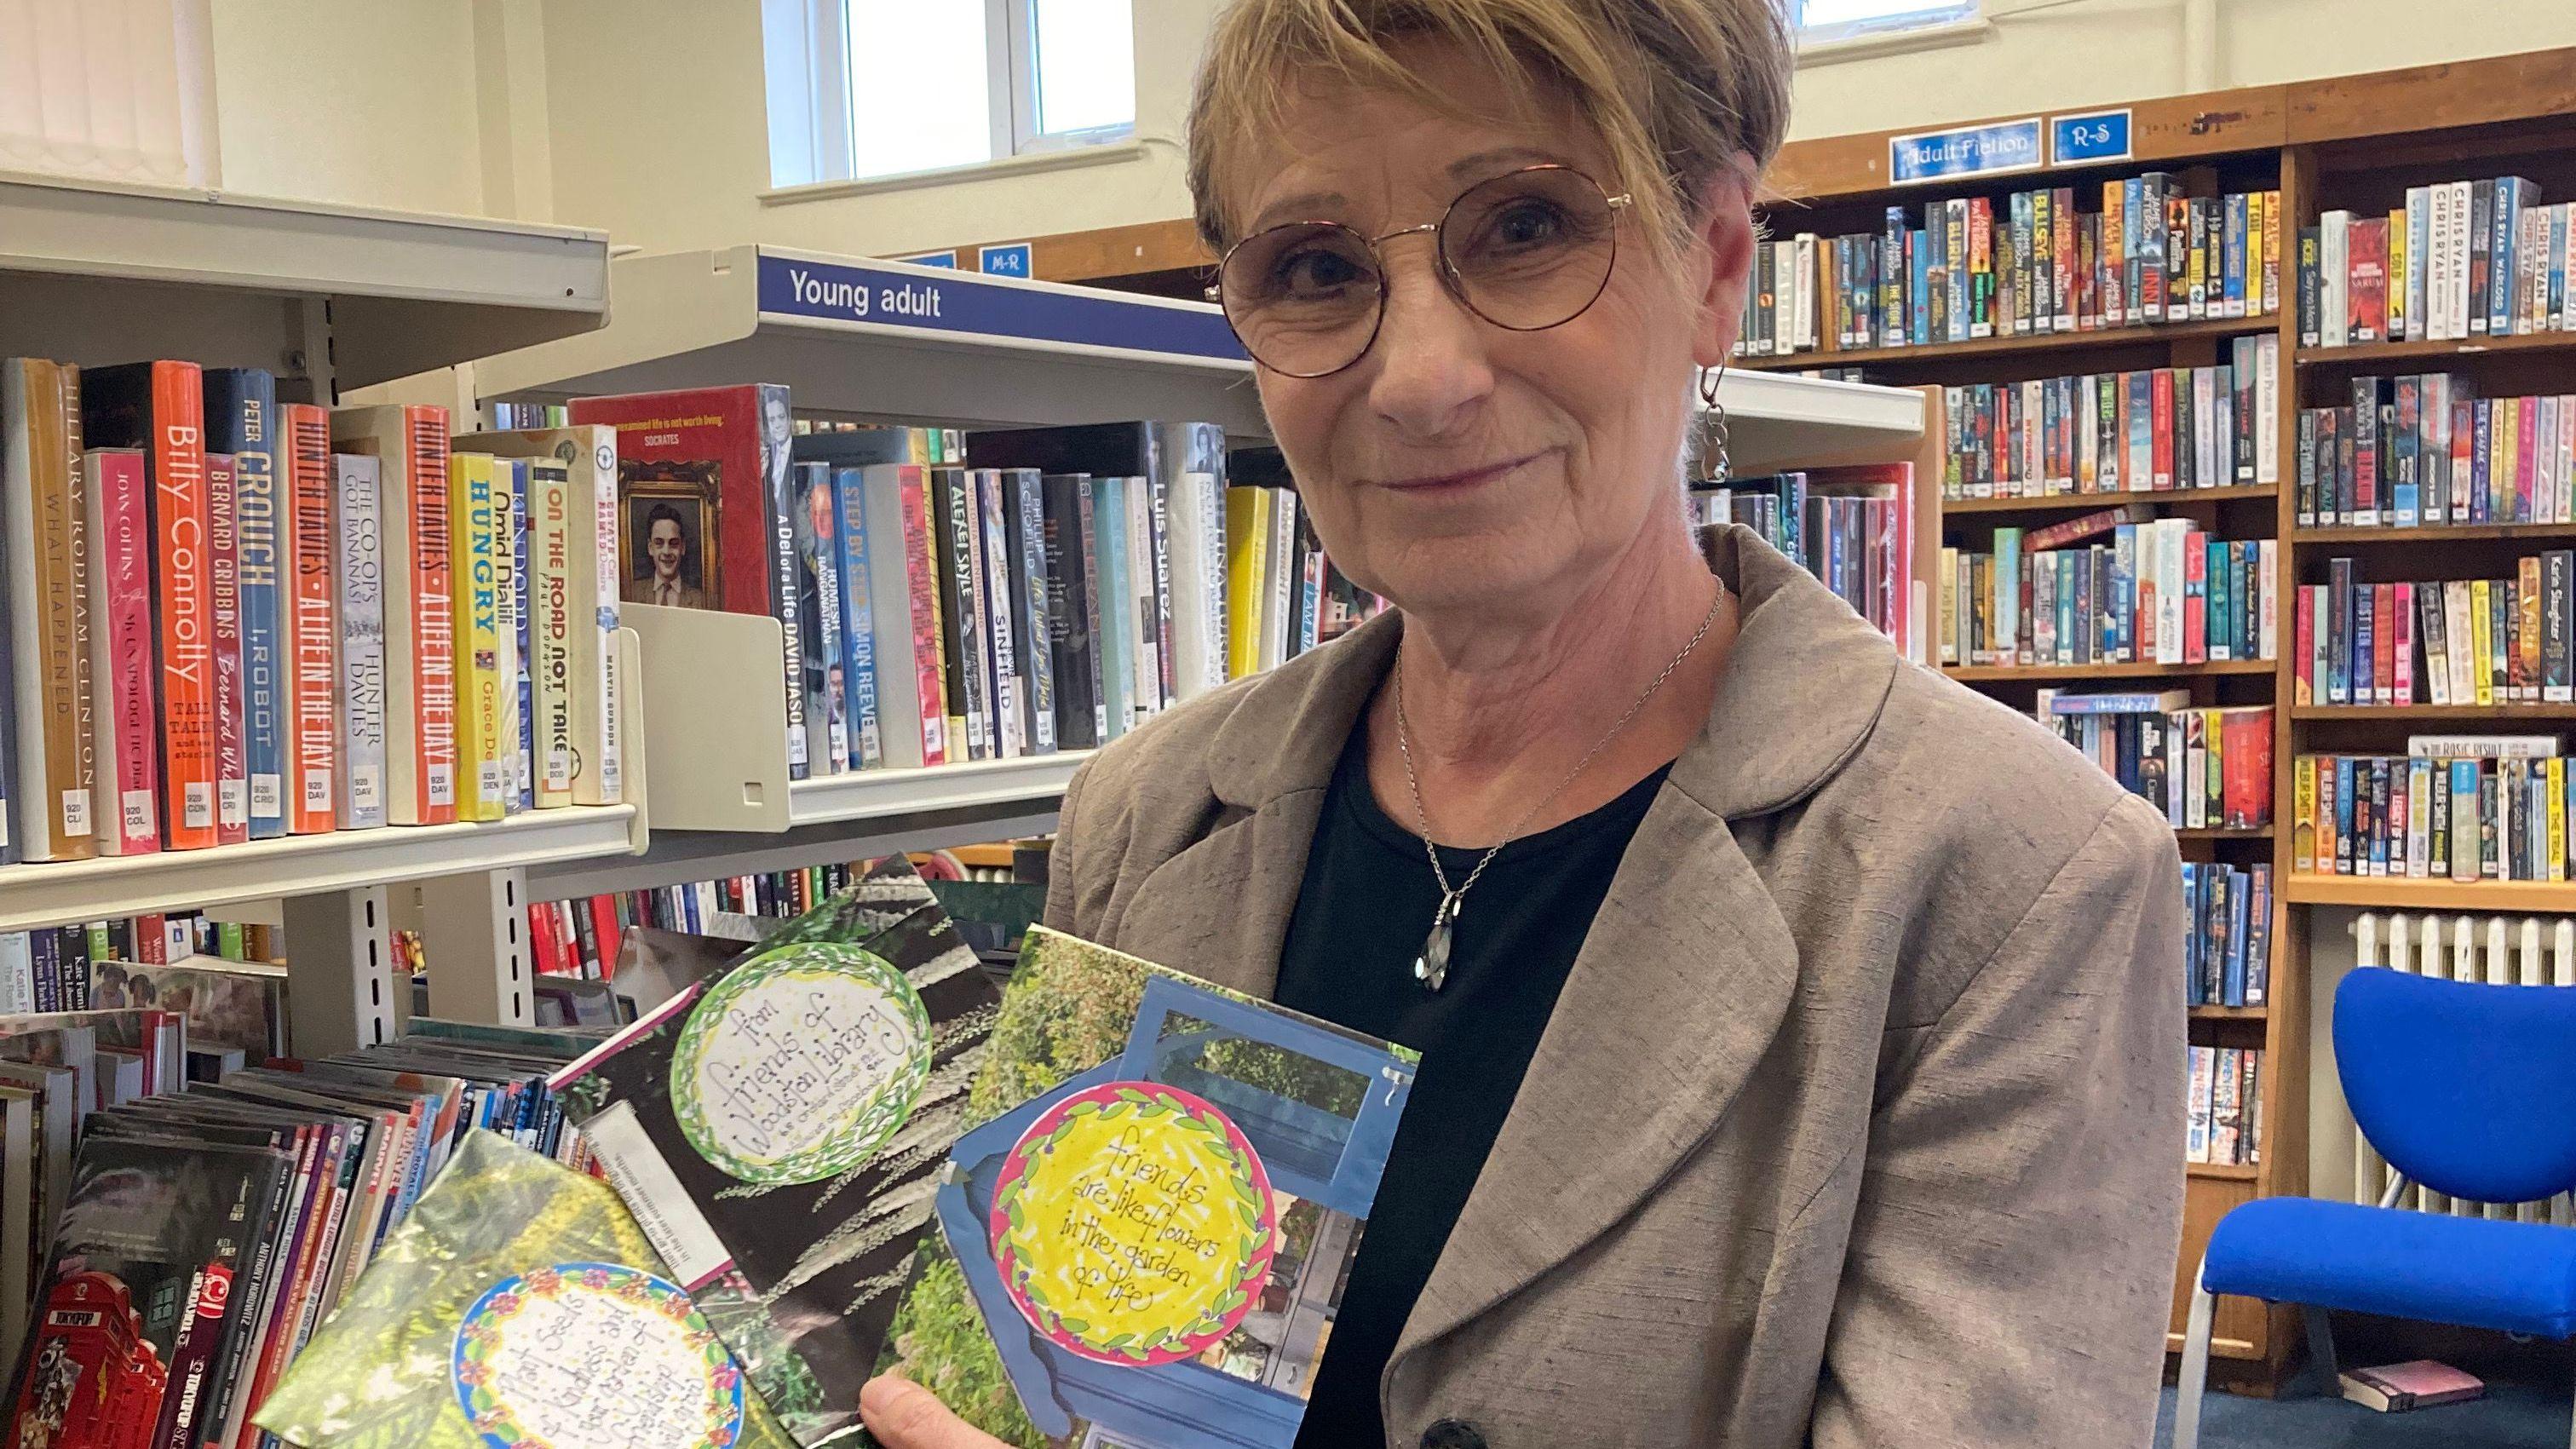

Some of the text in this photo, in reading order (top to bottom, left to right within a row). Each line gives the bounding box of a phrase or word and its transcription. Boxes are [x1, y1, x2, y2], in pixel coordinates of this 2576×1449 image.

[1906, 137, 2029, 168] Adult Fiction
[2073, 123, 2110, 146] R-S
[2034, 194, 2048, 262] BULLSEYE
[2435, 190, 2447, 281] CHRIS RYAN
[2452, 188, 2465, 279] CHRIS RYAN
[2496, 223, 2507, 253] RYAN
[2497, 186, 2508, 221] CHRIS
[992, 254, 1020, 271] M-R
[1947, 221, 1962, 271] BURN
[2536, 213, 2549, 299] CHRIS RYAN
[789, 269, 940, 318] Young adult
[644, 433, 680, 447] SOCRATES
[117, 470, 134, 583] JOAN COLLINS
[234, 399, 276, 586] PETER CROUCH
[296, 421, 331, 576] HUNTER DAVIES
[414, 420, 450, 572] HUNTER DAVIES
[494, 492, 512, 556] Omid
[607, 502, 616, 555] ESTATE
[844, 486, 864, 557] STEP BY
[1021, 481, 1035, 570] SCHOFIELD
[1032, 497, 1044, 555] PHILLIP
[1153, 482, 1166, 534] Luis
[157, 425, 208, 683] Billy Connolly
[211, 471, 235, 640] BERNARD CRIBBINS
[345, 474, 361, 604] GOT BANANAS!
[359, 477, 378, 603] THE CO-OP'S
[470, 480, 497, 635] HUNGRY
[513, 493, 527, 631] KEN DODD
[548, 529, 564, 569] THE
[952, 486, 974, 596] ALEXEI SAYLE
[45, 493, 70, 716] WHAT HAPPENED
[66, 385, 94, 785] HILLARY RODHAM CLINTON
[549, 577, 566, 640] ROAD
[777, 515, 803, 727] A Del of a Life DAVID JASO
[817, 556, 832, 645] RANGANATHAN
[826, 568, 842, 630] ROMESH
[2547, 556, 2563, 641] Karin Slaughter
[216, 655, 237, 744] Bernard
[298, 597, 334, 768] A LIFE IN THE DAY
[350, 663, 367, 738] DAVIES
[365, 654, 382, 747] HUNTER
[419, 591, 455, 760] A LIFE IN THE DAY
[552, 647, 566, 693] NOT
[853, 612, 877, 727] SIMON REEVE
[995, 614, 1012, 710] SINFIELD
[482, 681, 495, 733] Grace
[553, 699, 568, 752] TAKE
[127, 817, 146, 825] COL
[308, 791, 325, 800] DAV
[354, 788, 372, 796] DAV
[431, 785, 448, 794] DAV
[74, 956, 84, 980] Kate
[706, 1031, 800, 1118] friends
[804, 992, 838, 1032] of
[366, 1124, 395, 1190] MARVEL
[388, 1125, 418, 1192] MARVEL
[1106, 1125, 1206, 1205] friends
[1060, 1210, 1192, 1288] in the garden
[1072, 1175, 1221, 1258] are like flowers
[238, 1241, 272, 1327] ANTHONY HOROWITZ
[1073, 1267, 1153, 1313] of life
[177, 1372, 203, 1429] TOKYOPOP
